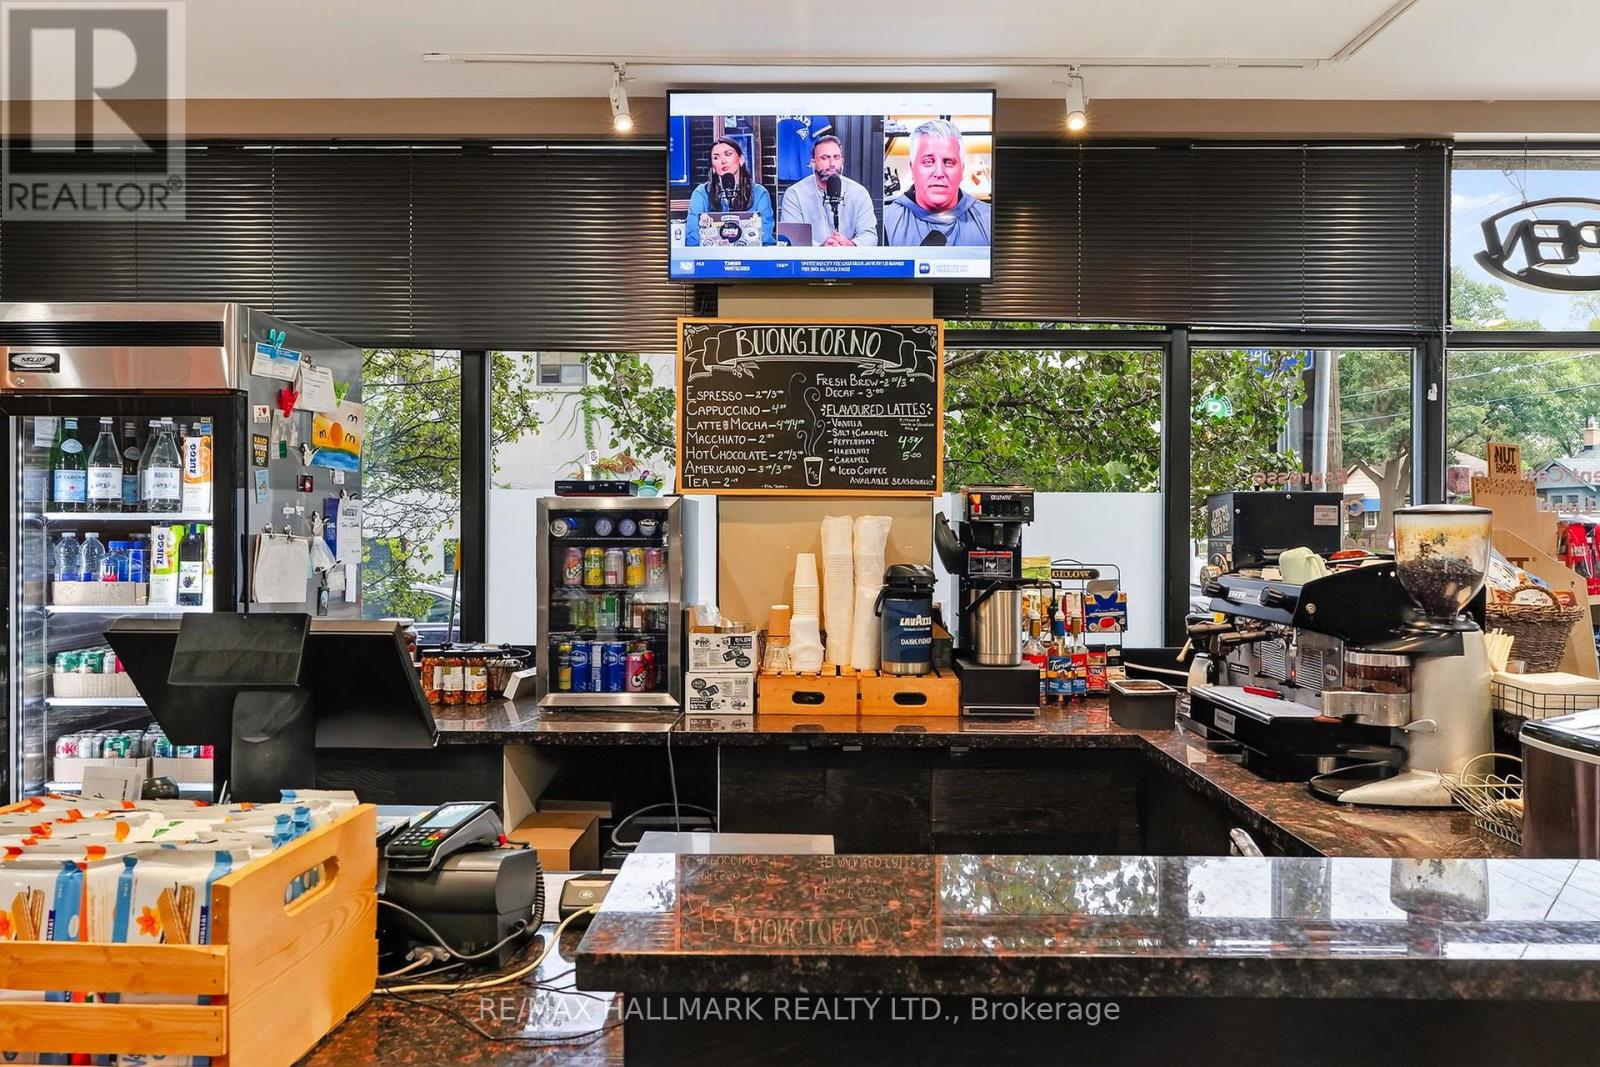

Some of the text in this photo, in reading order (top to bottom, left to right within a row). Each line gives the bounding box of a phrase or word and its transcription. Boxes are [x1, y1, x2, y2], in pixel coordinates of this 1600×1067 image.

[736, 328, 882, 357] BUONGIORNO
[816, 373, 847, 387] FRESH
[849, 373, 878, 387] BREW
[686, 386, 743, 401] ESPRESSO
[825, 387, 855, 397] DECAF
[686, 400, 761, 416] CAPPUCCINO
[826, 403, 926, 416] FLAVOURED LATTES
[686, 416, 721, 430] LATTE
[730, 417, 768, 430] MOCHA
[686, 431, 746, 445] MACCHIATO
[686, 446, 709, 459] HOT
[710, 445, 768, 460] CHOCOLATE
[1494, 446, 1516, 464] NUT
[684, 460, 746, 475] AMERICANO
[857, 466, 887, 475] COFFEE
[684, 475, 709, 487] TEA
[850, 476, 889, 485] AVAILABLE
